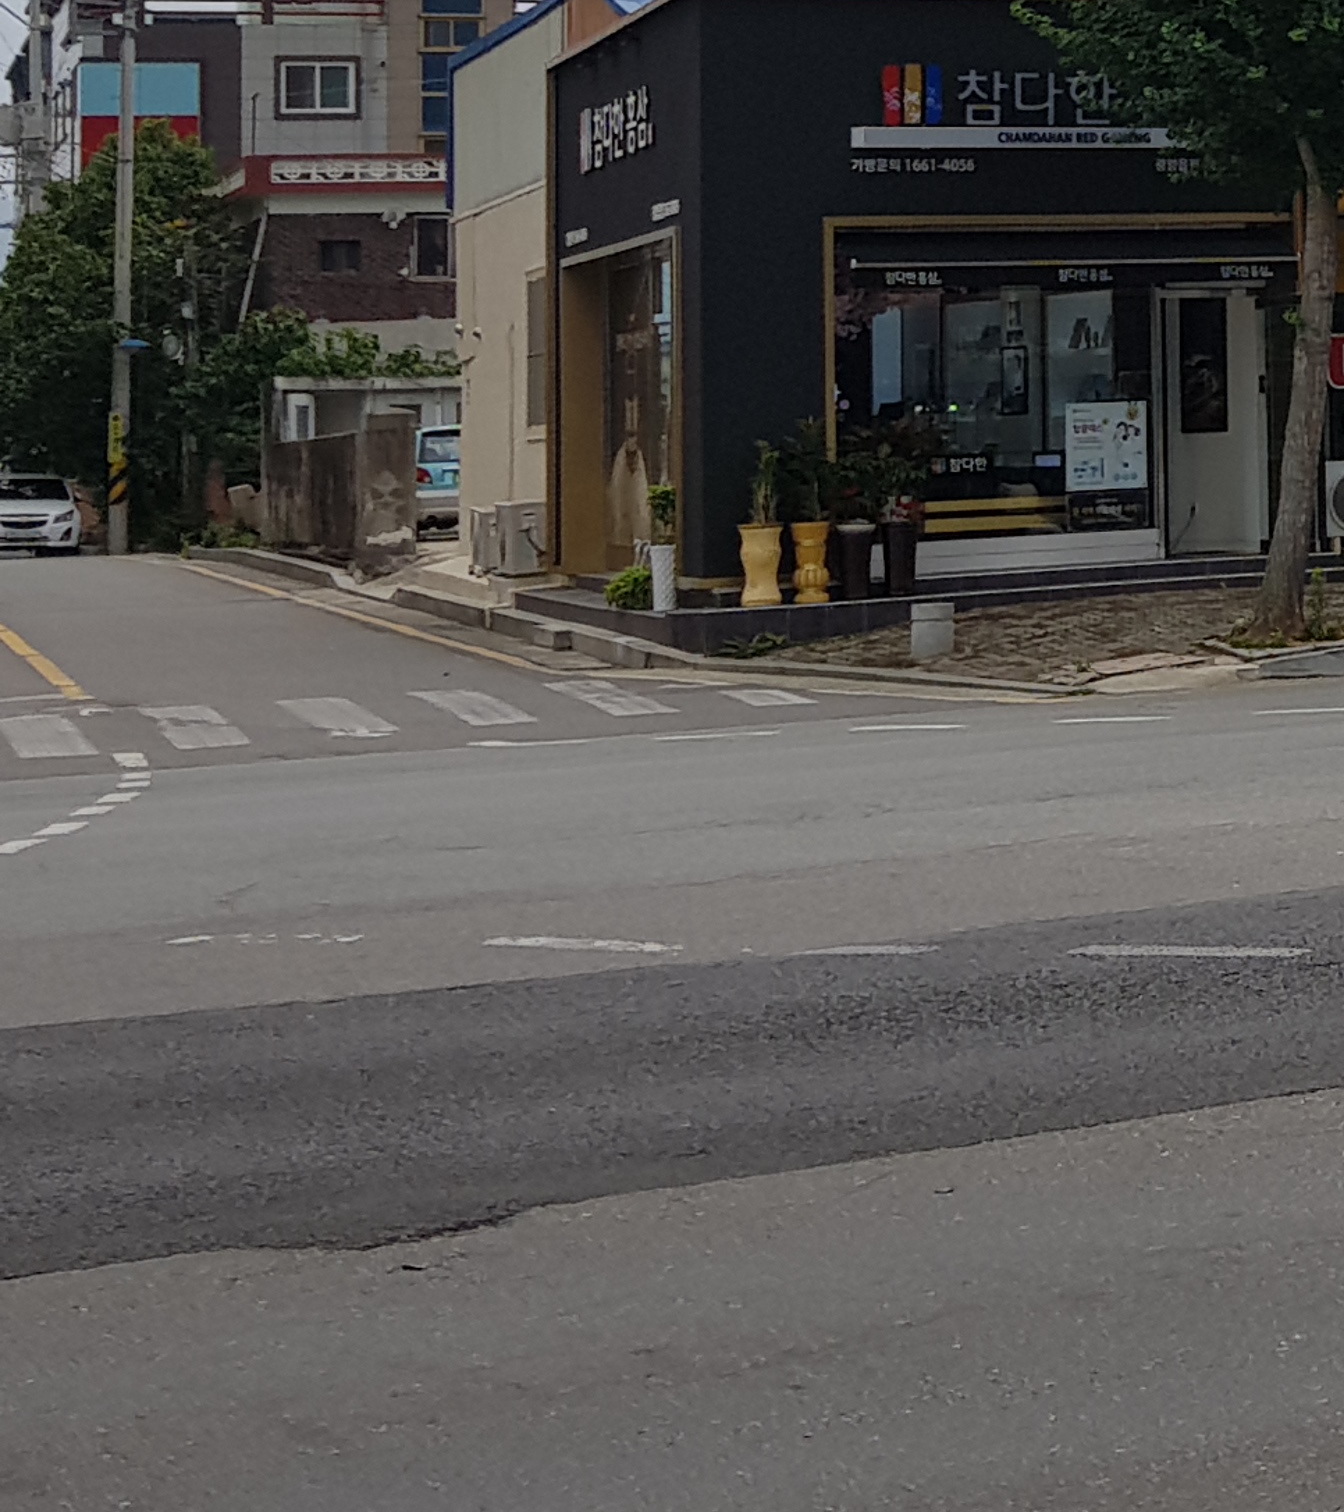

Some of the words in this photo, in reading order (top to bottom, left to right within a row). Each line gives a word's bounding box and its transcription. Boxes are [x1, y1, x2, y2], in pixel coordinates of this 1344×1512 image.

[998, 131, 1072, 143] CHAMDAHAN
[1076, 132, 1098, 143] RED
[904, 158, 975, 172] 1661-4056
